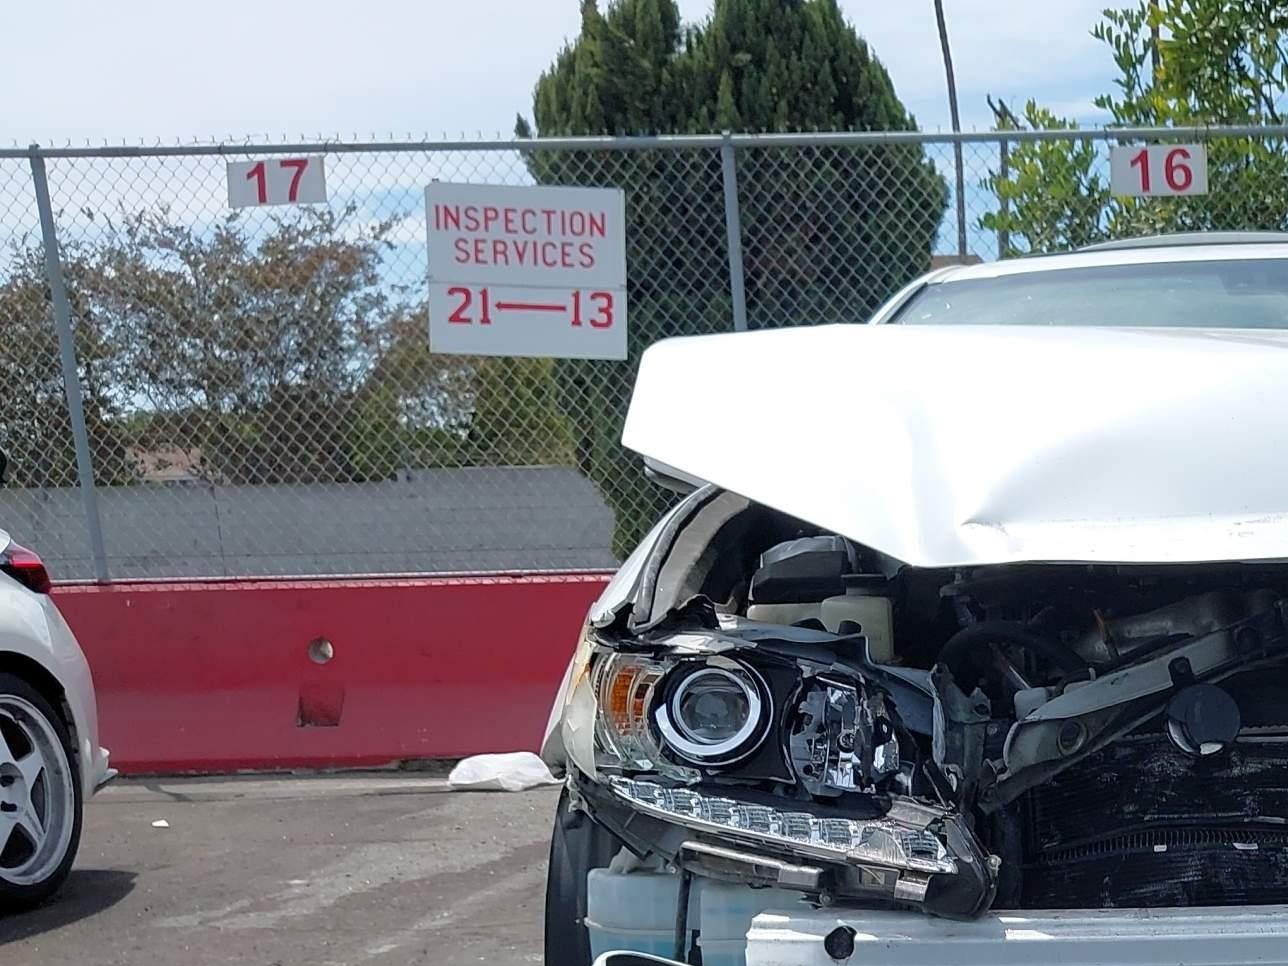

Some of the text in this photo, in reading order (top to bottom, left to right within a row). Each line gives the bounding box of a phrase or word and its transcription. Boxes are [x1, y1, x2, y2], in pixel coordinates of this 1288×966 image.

[246, 159, 309, 203] 17
[1130, 148, 1193, 193] 16
[434, 204, 606, 238] INSPECTION
[454, 238, 595, 269] SERVICES
[447, 287, 614, 329] 21 13
